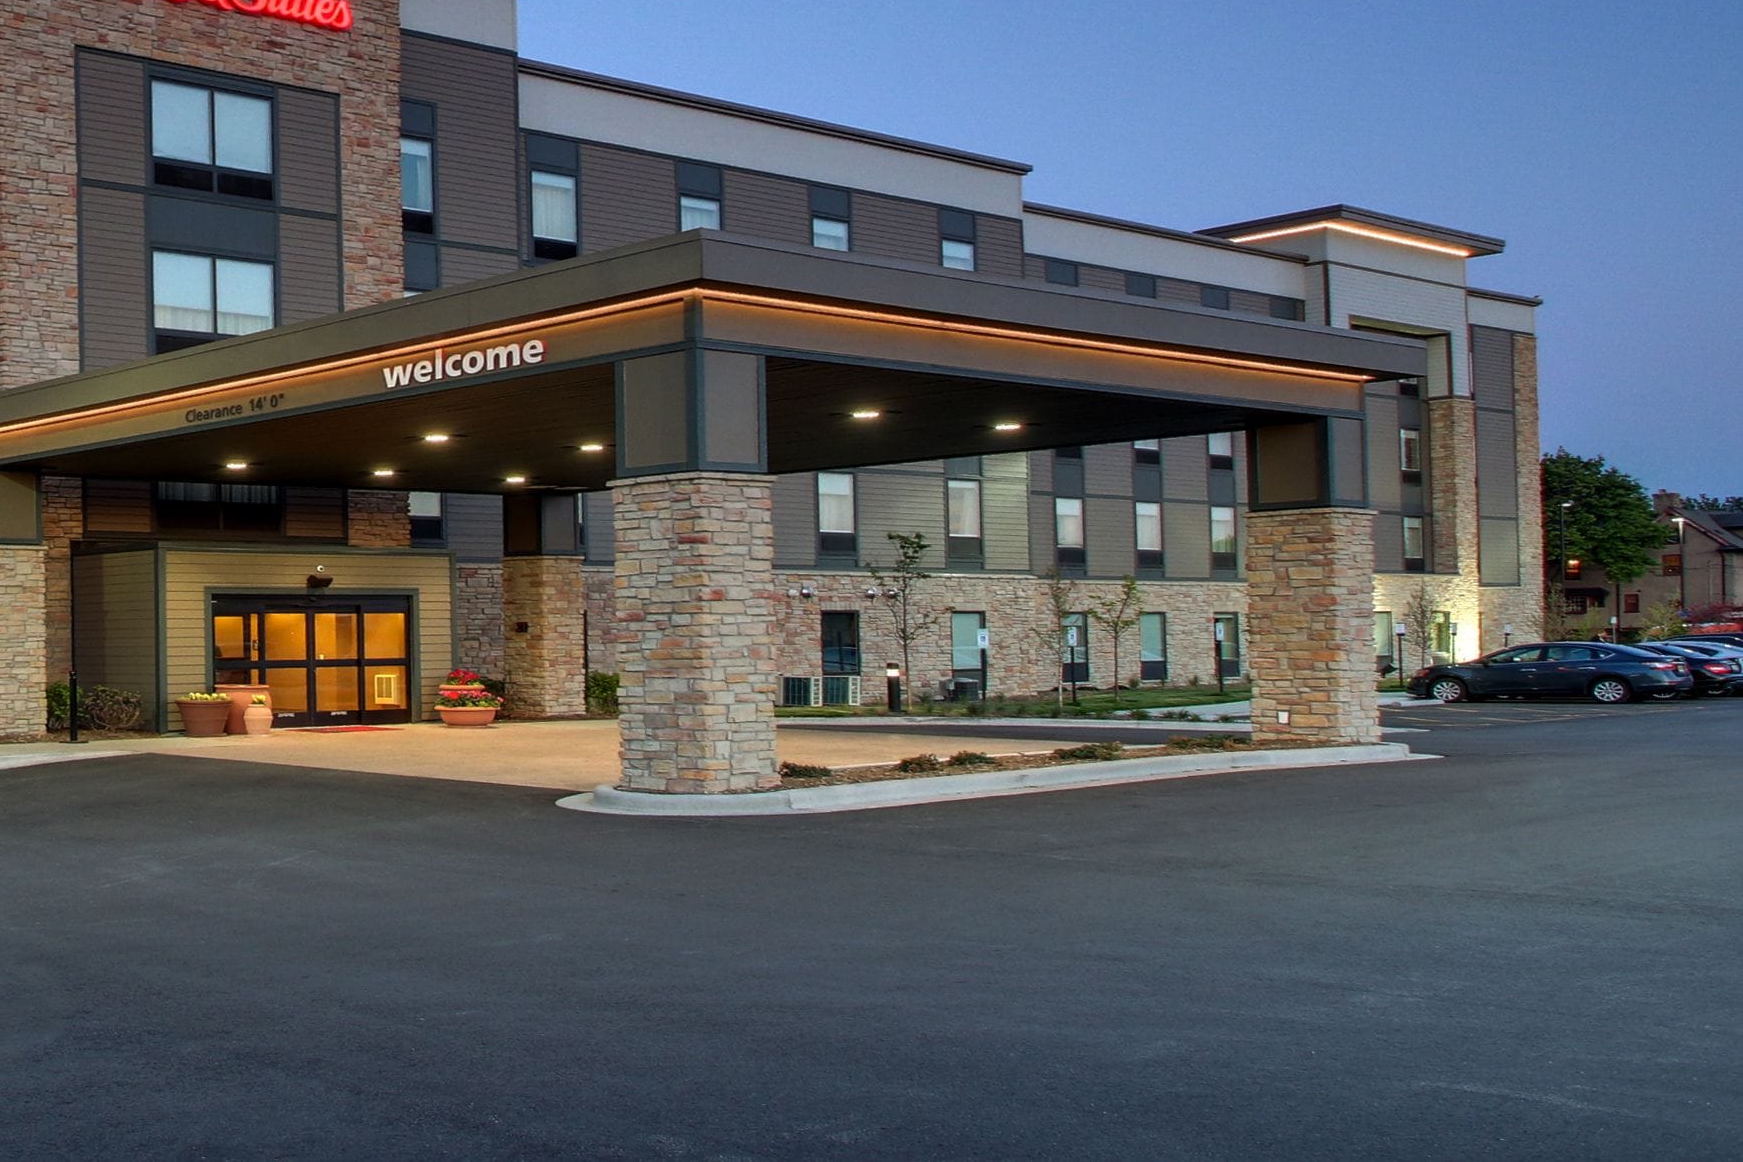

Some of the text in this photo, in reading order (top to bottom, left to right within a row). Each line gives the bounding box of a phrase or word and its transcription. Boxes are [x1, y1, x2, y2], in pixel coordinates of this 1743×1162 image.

[382, 339, 547, 389] welcome
[185, 404, 243, 423] Clearance
[249, 396, 267, 412] 14'
